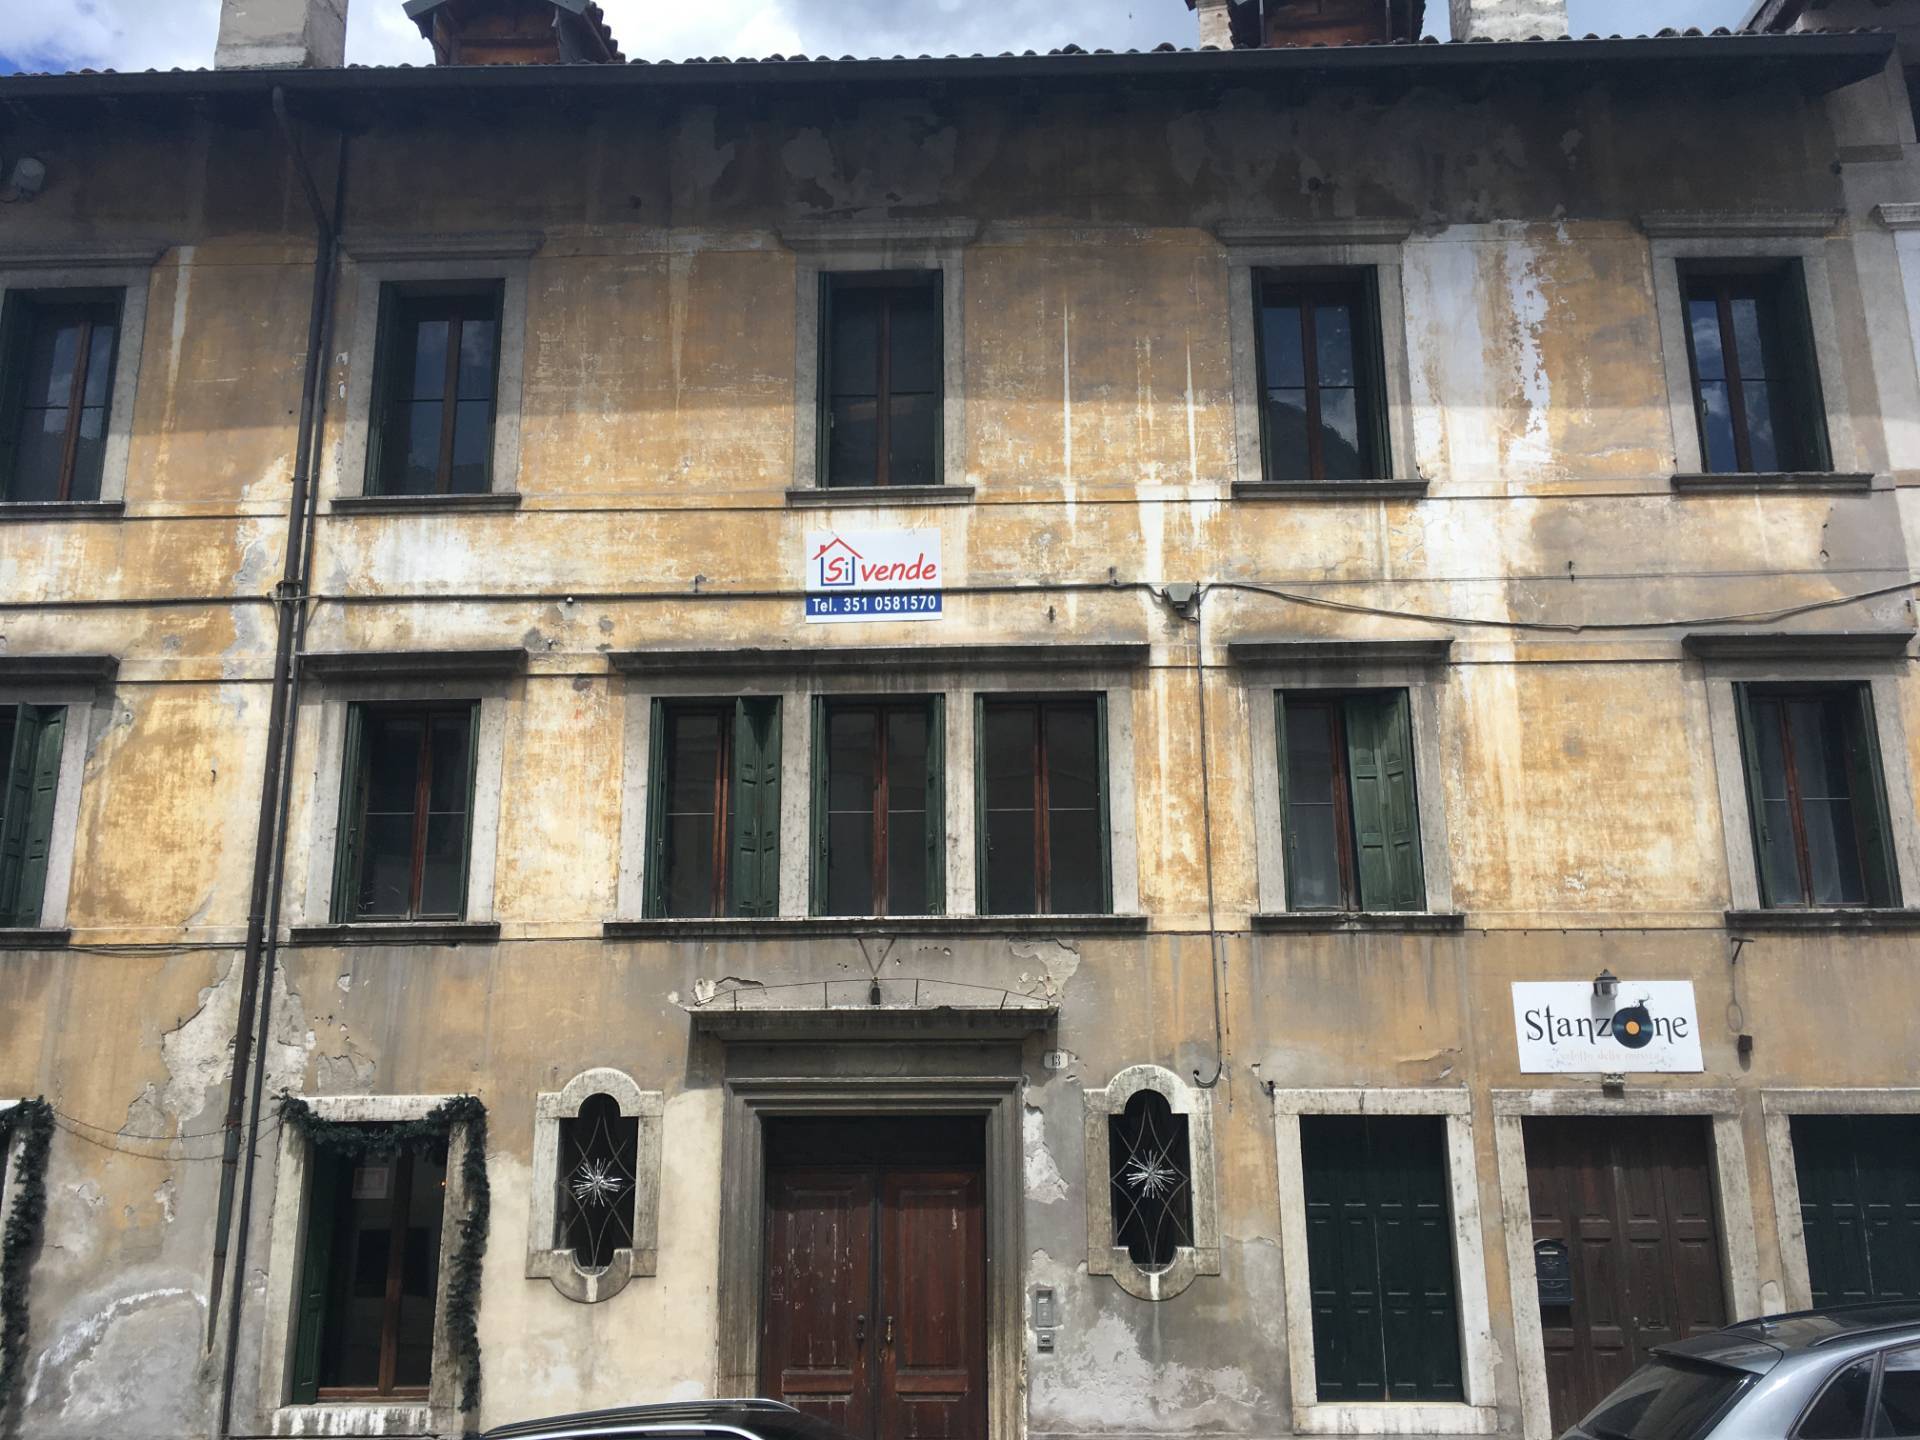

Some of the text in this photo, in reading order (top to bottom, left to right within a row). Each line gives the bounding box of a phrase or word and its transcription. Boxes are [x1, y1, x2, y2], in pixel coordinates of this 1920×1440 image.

[825, 553, 937, 582] Si vende
[813, 595, 936, 612] Tel. 351 0581570
[1051, 1054, 1061, 1066] 13
